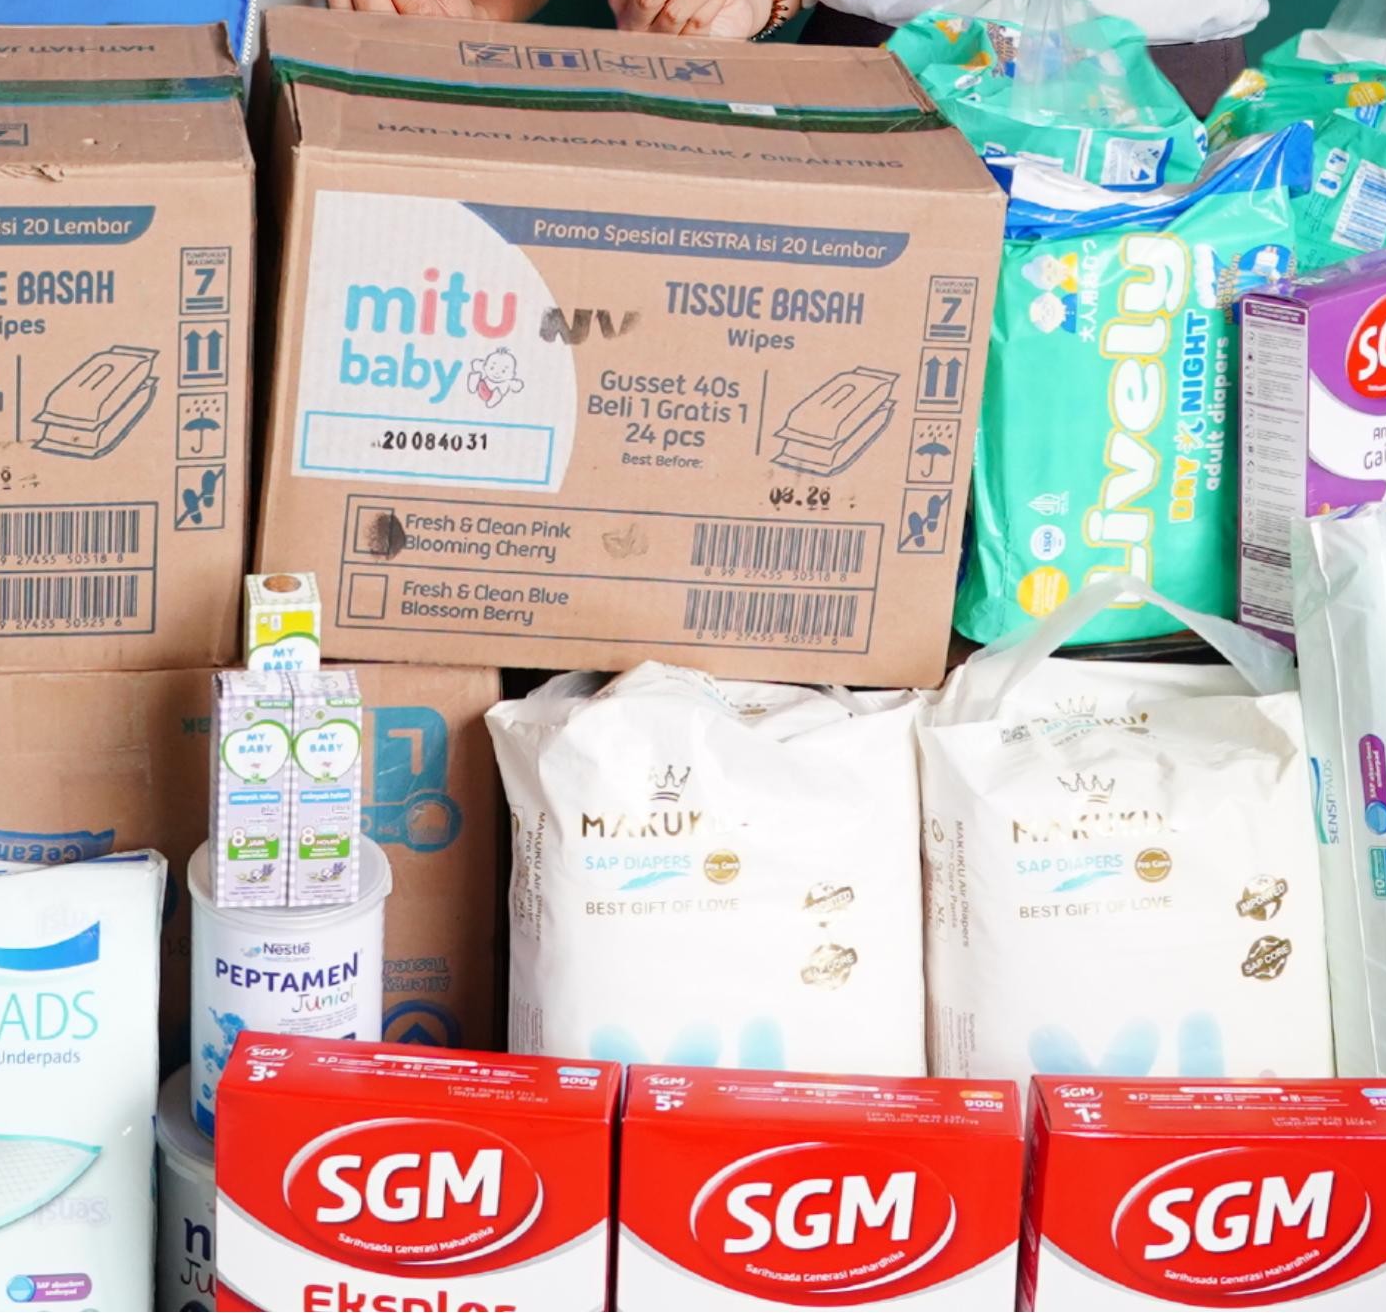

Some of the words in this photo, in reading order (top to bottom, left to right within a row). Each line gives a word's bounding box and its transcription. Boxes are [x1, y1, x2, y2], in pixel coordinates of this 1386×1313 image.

[23, 218, 49, 235] 20
[54, 218, 133, 236] Lembar
[534, 220, 599, 241] Promo
[604, 224, 675, 247] Spesial
[679, 230, 751, 251] EKSTRA
[756, 234, 777, 251] isi
[782, 237, 807, 255] 20
[812, 240, 887, 260] Lembar
[17, 270, 115, 306] BASAH
[344, 267, 518, 339] mitu
[665, 281, 763, 320] TISSUE
[771, 287, 864, 325] BASAH
[727, 328, 795, 353] Wipes
[339, 338, 463, 404] baby
[1180, 309, 1210, 416] NIGHT
[600, 370, 687, 396] Gusset
[693, 375, 740, 399] 40s
[1207, 337, 1232, 424] diapers
[587, 394, 633, 418] Beli
[656, 399, 731, 423] Gratis
[1081, 232, 1190, 609] Lively
[625, 423, 656, 444] 24
[663, 428, 706, 451] pcs
[621, 452, 652, 466] Best
[1204, 431, 1226, 491] adult
[1169, 456, 1201, 524] DRY
[405, 513, 455, 533] Fresh
[476, 517, 527, 537] Clean
[531, 520, 571, 538] Pink
[404, 534, 491, 560] Blooming
[496, 539, 557, 564] Cherry
[403, 580, 453, 599] Fresh
[474, 584, 524, 604] Clean
[528, 587, 569, 605] Blue
[401, 601, 479, 620] Blossom
[483, 605, 534, 627] Berry
[263, 660, 303, 671] BABY
[246, 733, 265, 742] MY
[309, 743, 344, 752] BABY
[317, 732, 337, 741] MY
[238, 744, 273, 754] BABY
[231, 826, 246, 847] 8
[301, 826, 315, 846] 8
[585, 855, 619, 871] SAP
[623, 855, 693, 871] DIAPERS
[1016, 859, 1052, 875] SAP
[1056, 853, 1125, 873] DIAPERS
[585, 901, 626, 916] BEST
[631, 900, 667, 916] GIFT
[672, 899, 694, 914] OF
[697, 897, 741, 912] LOVE
[1019, 904, 1062, 919] BEST
[1065, 902, 1102, 917] GIFT
[1106, 899, 1127, 915] OF
[1130, 895, 1174, 911] LOVE
[1243, 954, 1265, 976] SAP
[1263, 942, 1292, 966] CORE
[215, 951, 359, 993] PEPTAMEN
[249, 1045, 289, 1060] SGM
[248, 1065, 278, 1081] 3+
[558, 1074, 598, 1088] 900g
[648, 1075, 687, 1087] SGM
[655, 1095, 685, 1112] 5+
[963, 1098, 1004, 1111] 900g
[1058, 1086, 1096, 1099] SGM
[1074, 1107, 1102, 1123] 1+
[316, 1149, 503, 1224] SGM
[724, 1171, 917, 1255] SGM
[1143, 1169, 1335, 1261] SGM
[395, 1242, 439, 1255] Generasi
[803, 1270, 849, 1284] Generasi
[1220, 1271, 1264, 1286] Generasi
